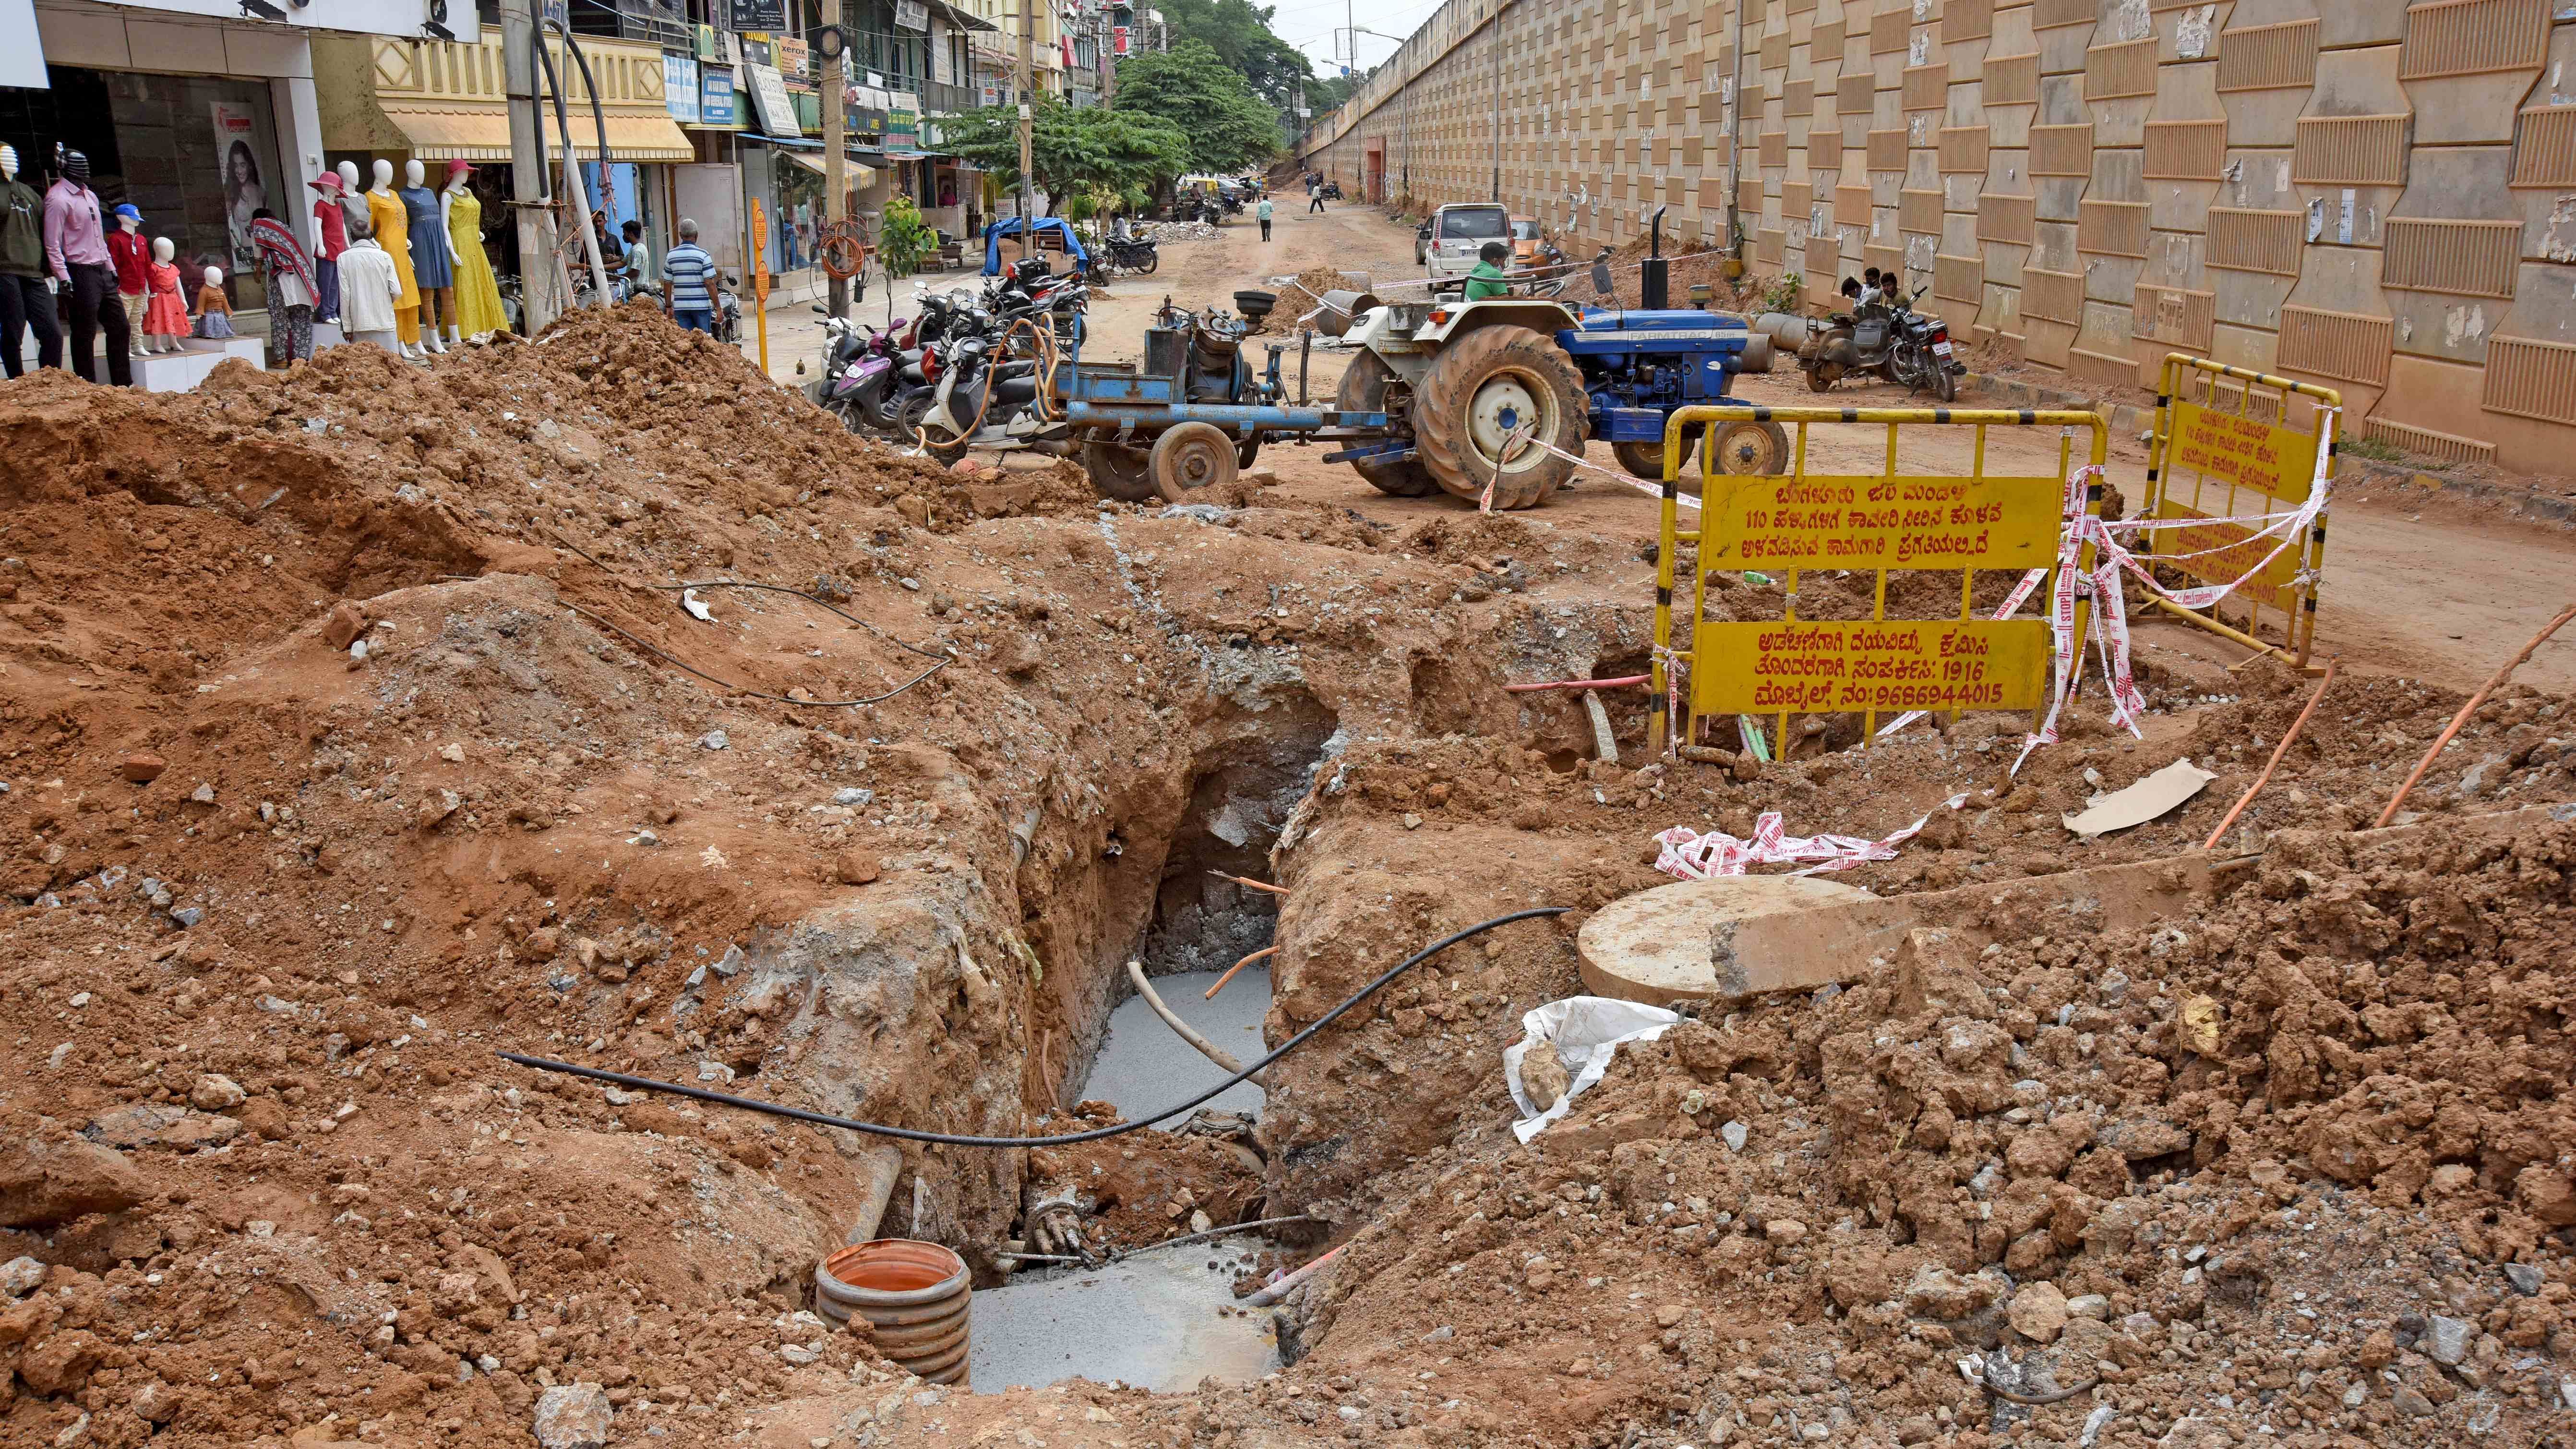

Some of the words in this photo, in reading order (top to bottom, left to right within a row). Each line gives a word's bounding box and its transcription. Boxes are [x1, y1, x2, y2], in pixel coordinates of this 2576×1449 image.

[782, 46, 805, 55] xerox
[1776, 483, 1854, 504] ಬೆಂಗಳೂರು
[1746, 510, 1767, 529] 110
[1848, 509, 1898, 529] ಕಾವೇರಿ
[1950, 502, 2002, 526] ಕೊಳವೆ
[1742, 534, 1819, 558] ಅಳವಡಿಸುವ
[1827, 536, 1885, 556] ಕಾಮಗಾರಿ
[2061, 597, 2071, 621] STOP
[1758, 627, 1843, 652] ಅಡಚಣೆಗಾಗಿ
[1850, 628, 1923, 655] ದಯವಿಟ್ಟು
[1754, 653, 1846, 678] ತೊಂದರೆಗಾಗಿ
[1943, 660, 1985, 682] 1916
